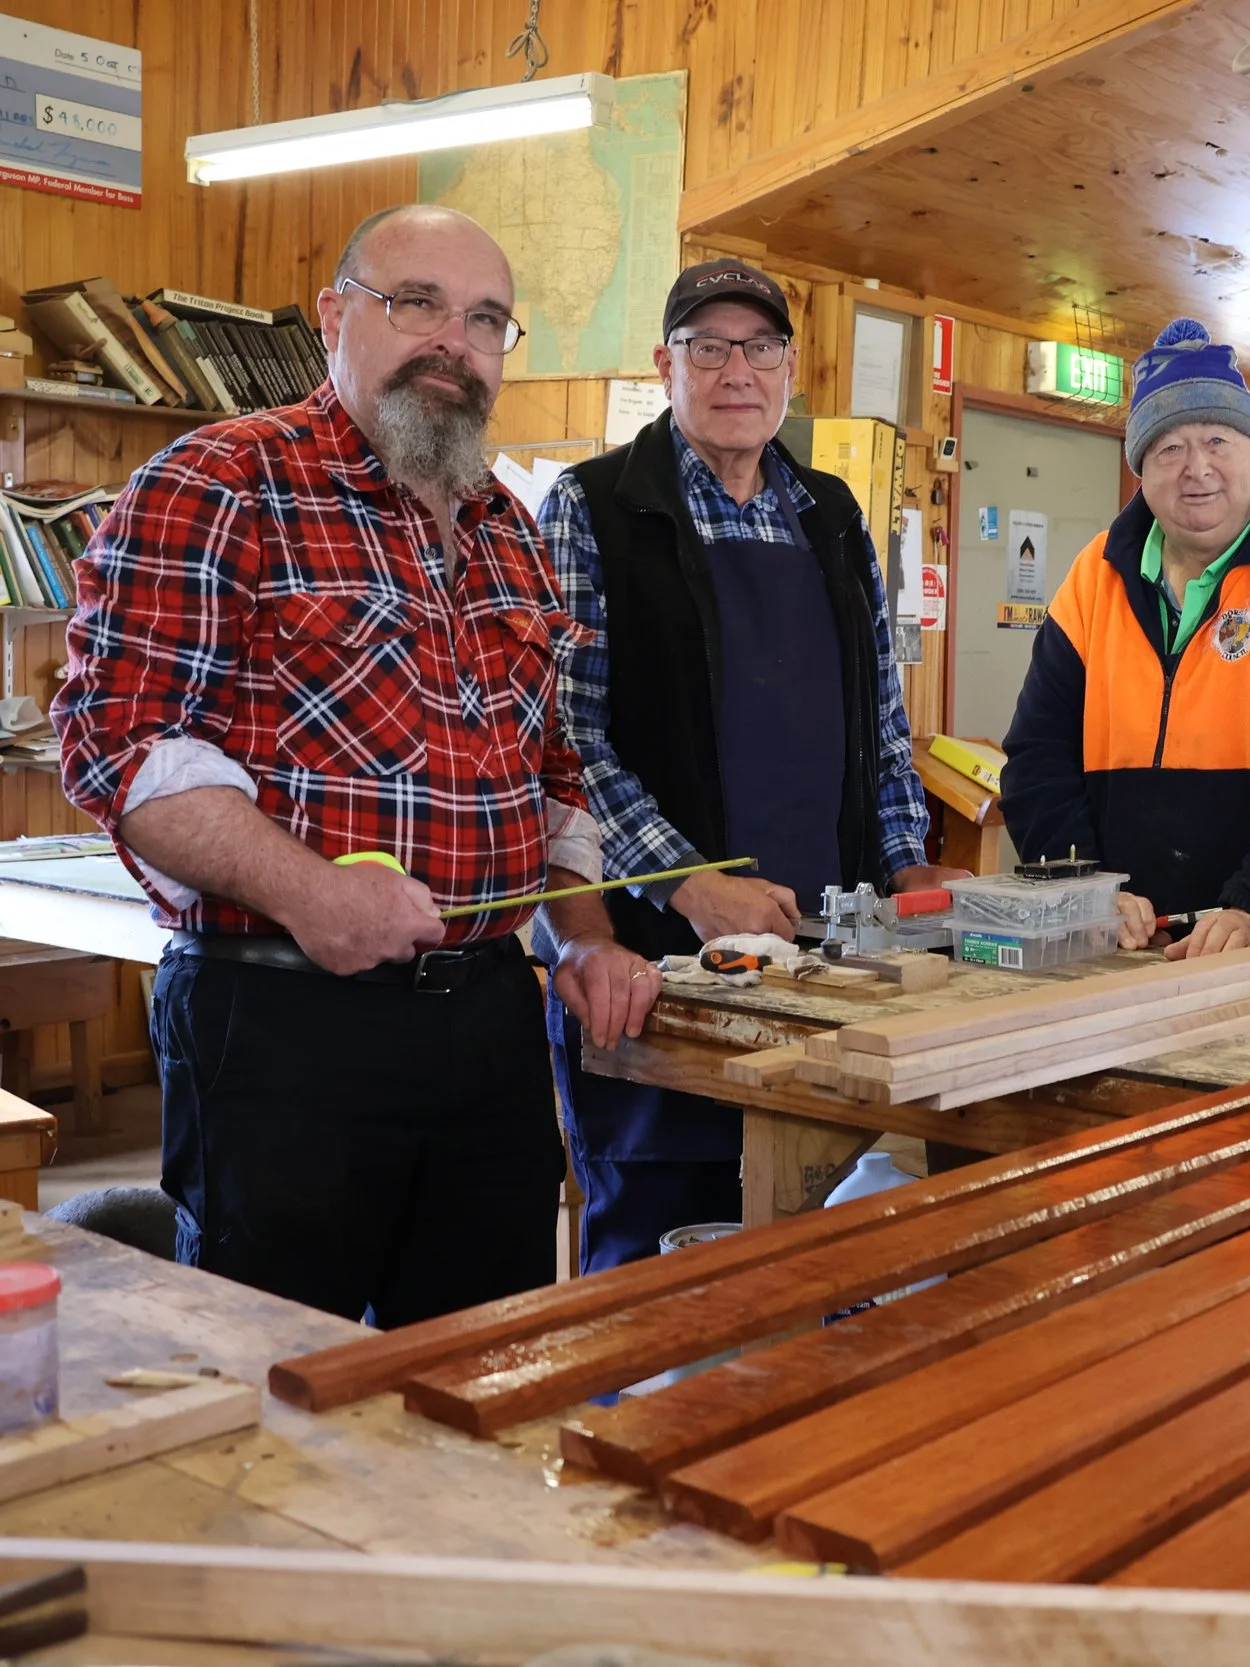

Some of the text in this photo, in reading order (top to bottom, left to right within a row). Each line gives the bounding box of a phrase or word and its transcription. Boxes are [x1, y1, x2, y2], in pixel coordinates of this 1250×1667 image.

[55, 48, 75, 62] Date
[43, 178, 72, 190] Federal
[74, 183, 104, 196] Member
[105, 189, 116, 199] for
[173, 293, 265, 320] The Triton Project Book
[1070, 353, 1108, 393] EXIT
